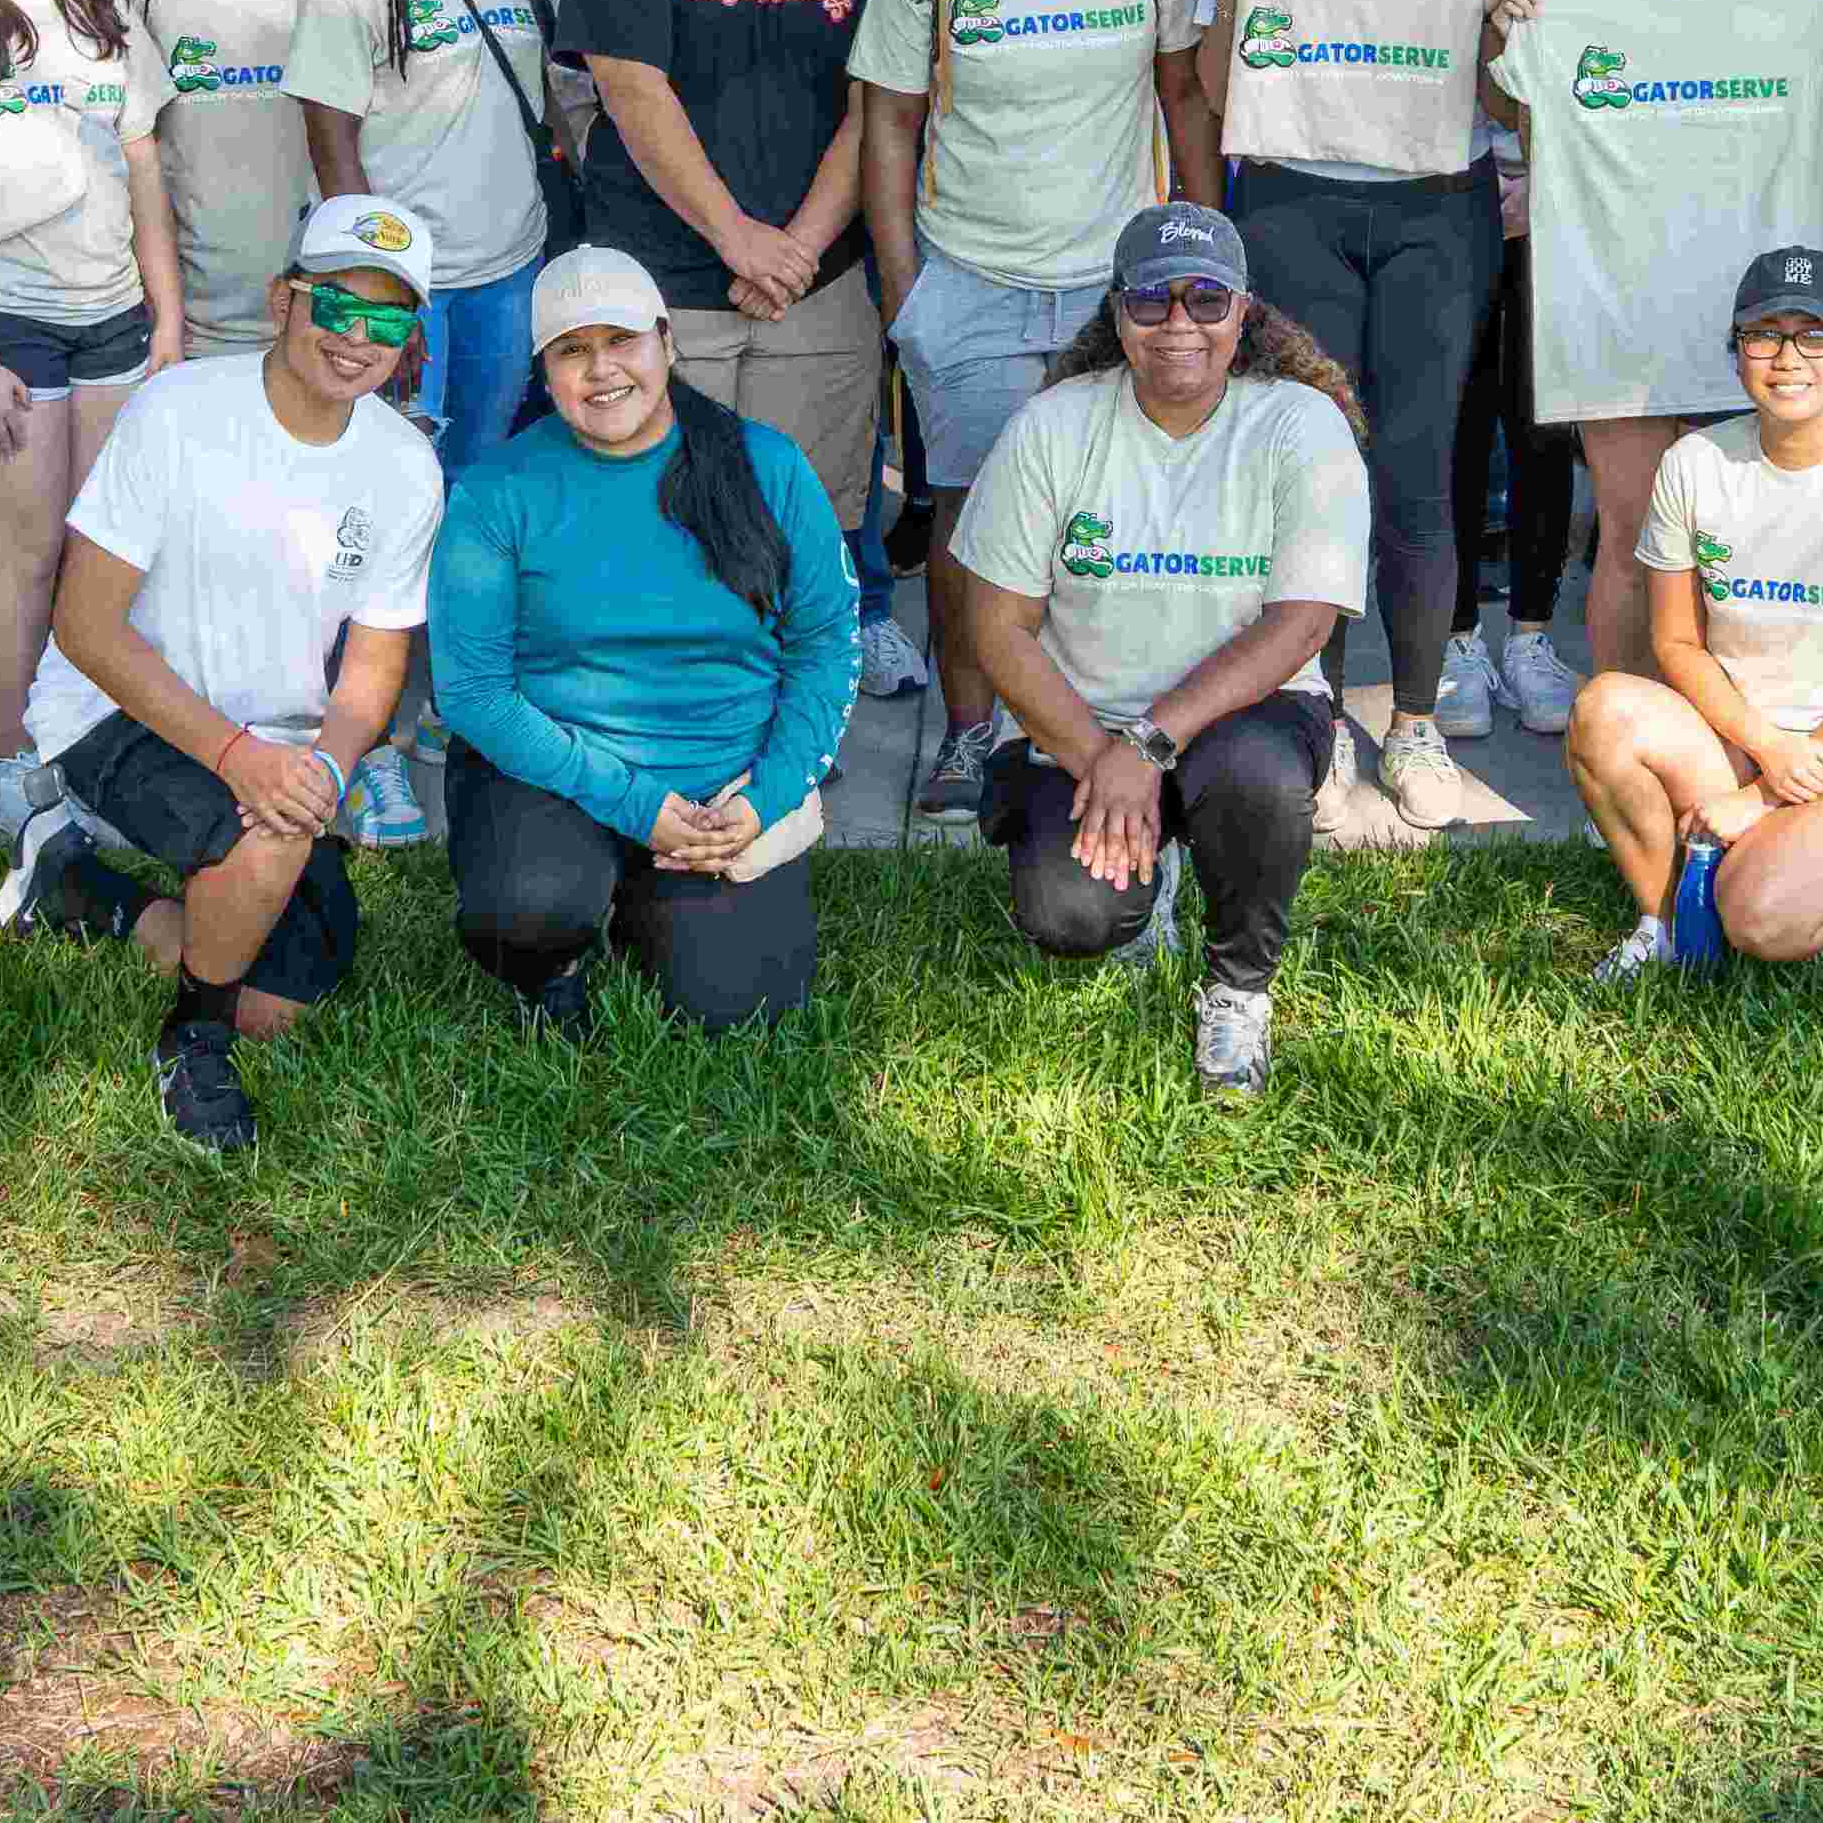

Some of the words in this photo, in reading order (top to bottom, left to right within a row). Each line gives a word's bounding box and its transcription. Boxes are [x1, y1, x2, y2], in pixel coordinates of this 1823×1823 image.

[1005, 2, 1145, 36] GATORSERVE
[1297, 42, 1450, 69] GATORSERVE
[1633, 77, 1789, 103] GATORSERVE
[1786, 257, 1812, 267] GOD
[1785, 274, 1813, 285] ME
[1115, 550, 1272, 578] GATORSERVE
